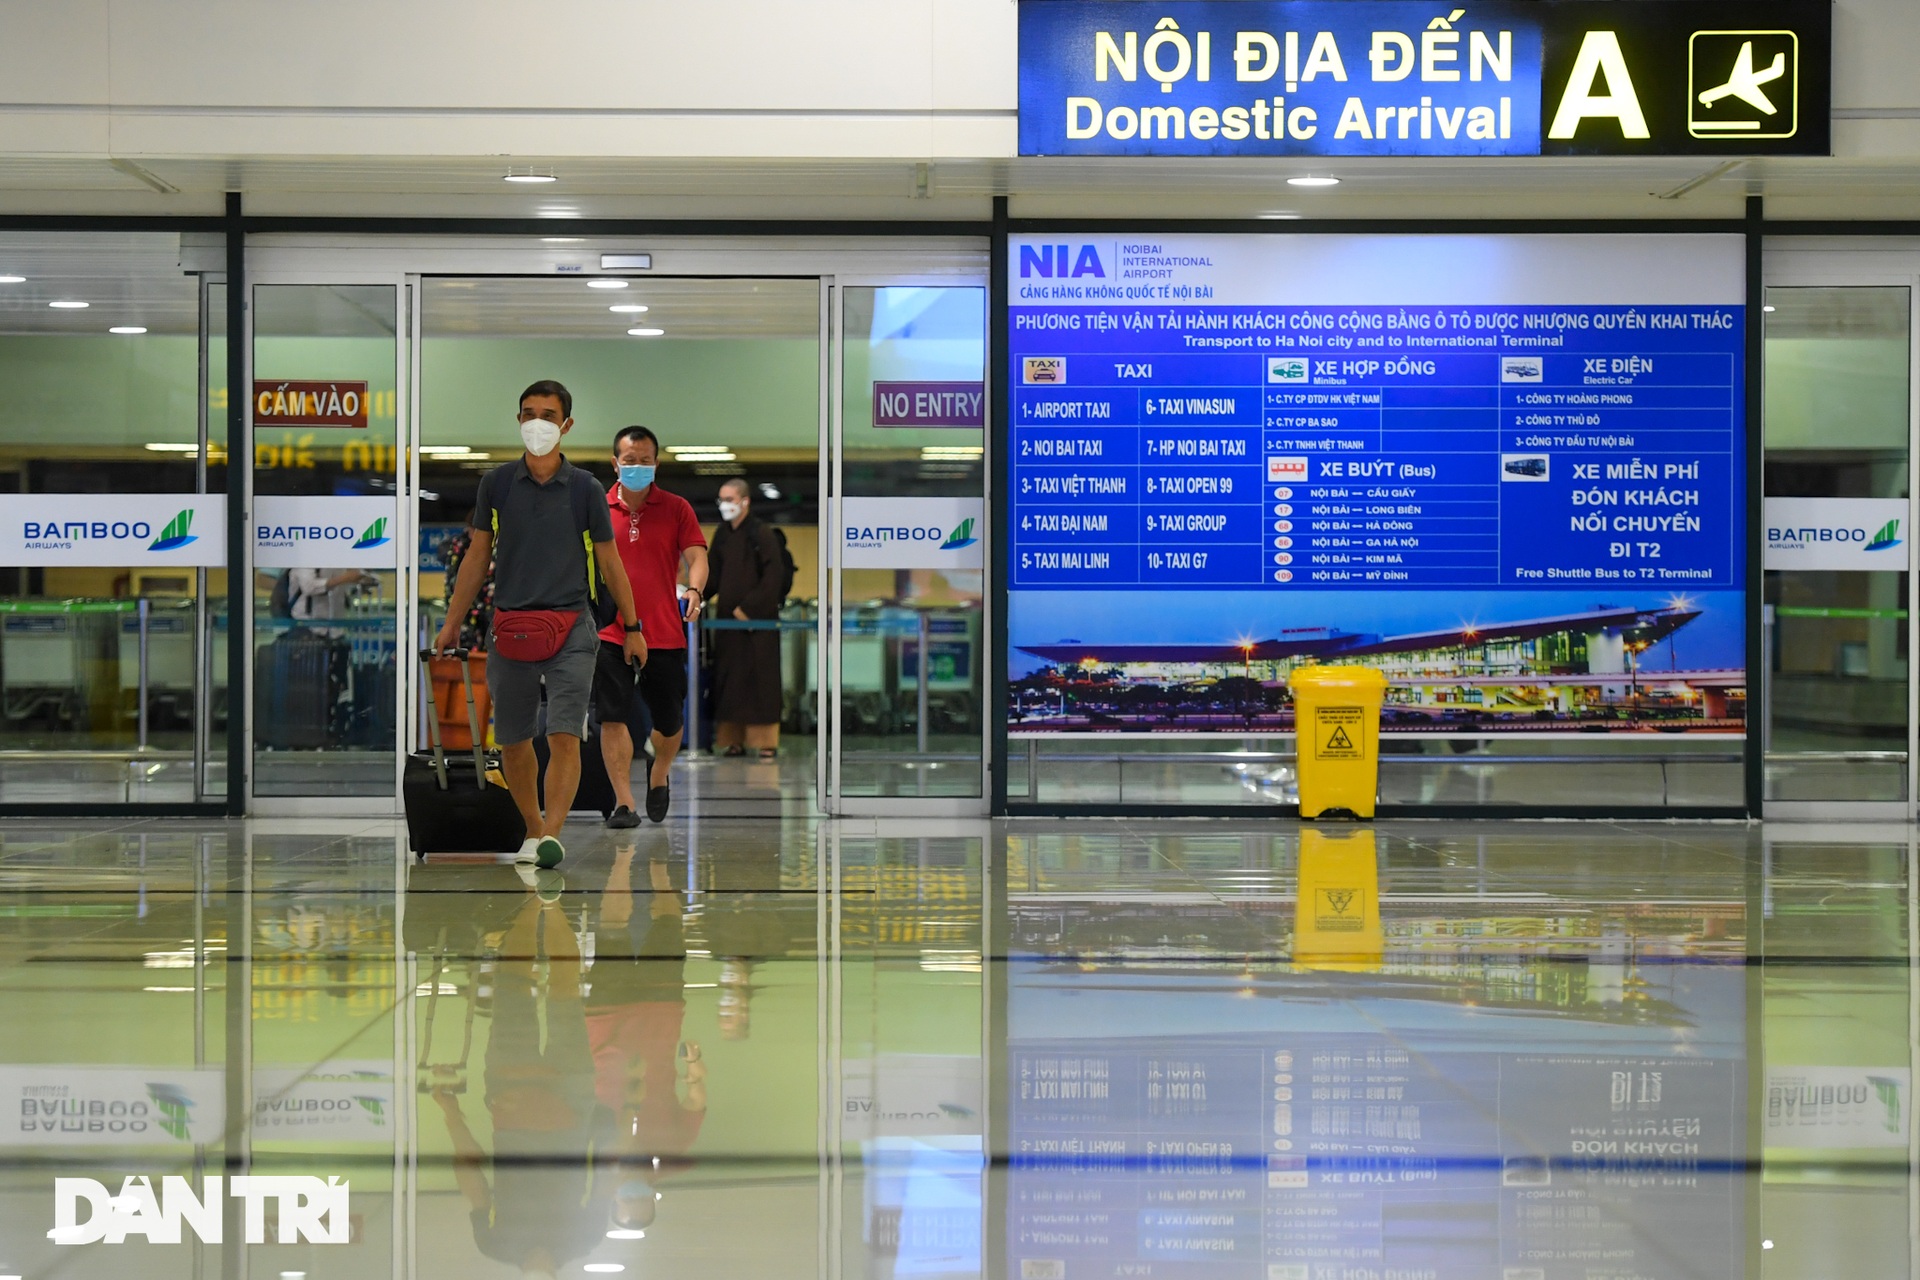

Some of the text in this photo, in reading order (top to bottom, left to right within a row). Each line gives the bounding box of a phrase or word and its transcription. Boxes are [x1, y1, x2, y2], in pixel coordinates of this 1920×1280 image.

[1090, 10, 1512, 93] NỘI ĐỊA ĐẾN
[1548, 31, 1650, 139] A
[1067, 96, 1511, 140] Domestic Arrival
[1123, 245, 1162, 254] NOIBAI
[1020, 245, 1105, 278] NIA
[1123, 257, 1212, 266] INTERNATIONAL
[1123, 269, 1173, 278] AIRPORT
[1020, 283, 1212, 301] CẢNG HÀNG KHÔNG QUỐC TẾ NỘI BÀI
[1016, 308, 1732, 333] PHƯƠNG TIỆN VẬN TẢI HÀNH KHÁCH CÔNG CỘNG BẰNG Ô TÔ ĐƯỢC NHƯỢNG QUYỀN KHAI THÁC
[1183, 335, 1563, 349] Transport to Ha Noi city and to International Terminal
[1029, 361, 1060, 369] TAXI
[1114, 364, 1152, 378] TAXI
[1314, 355, 1435, 378] XE HỢP ĐỒNG
[1584, 356, 1652, 378] XE ĐIỆN
[1313, 377, 1347, 385] Minibus
[1583, 376, 1633, 384] Electric Car
[258, 383, 305, 416] CẤM
[313, 384, 359, 417] VÀO
[880, 392, 982, 418] NO ENTRY
[1158, 399, 1184, 414] TAXI
[1186, 398, 1235, 414] VINASUN
[1554, 395, 1565, 403] TY
[1601, 395, 1633, 404] PHONG
[1034, 402, 1083, 418] AIRPORT
[1085, 402, 1110, 418] TAXI
[1295, 418, 1306, 427] CP
[1308, 418, 1320, 427] BA
[1321, 418, 1338, 427] SAO
[1554, 416, 1565, 425] TY
[1034, 440, 1053, 456] NOI
[1056, 440, 1075, 456] BAI
[1077, 440, 1102, 456] TAXI
[1160, 440, 1175, 455] HP
[1178, 440, 1196, 456] NOI
[1200, 440, 1218, 456] BAI
[1220, 440, 1245, 456] TAXI
[1553, 437, 1565, 446] TY
[1601, 435, 1617, 448] NỘI
[1320, 459, 1436, 479] XE BUÝT (Bus)
[1573, 458, 1699, 479] XE MIỄN PHÍ
[1034, 477, 1059, 493] TAXI
[1061, 474, 1086, 497] VIỆT
[1088, 477, 1126, 493] THANH
[1159, 477, 1184, 493] TAXI
[1187, 477, 1217, 493] OPEN
[1220, 477, 1232, 493] 99
[1571, 486, 1698, 505] ĐÓN KHÁCH
[1279, 506, 1289, 514] 17
[1366, 506, 1395, 514] LONG
[1034, 515, 1059, 531] TAXI
[1061, 515, 1080, 535] ĐẠI
[1083, 515, 1107, 531] NAM
[1159, 515, 1184, 531] TAXI
[1187, 515, 1226, 531] GROUP
[1571, 510, 1700, 531] NỐI CHUYẾN
[24, 522, 150, 540] BAMBOO
[258, 526, 354, 540] BAMBOO
[846, 527, 942, 541] BAMBOO
[1768, 528, 1866, 542] BAMBOO
[1610, 542, 1660, 557] ĐI T2
[1034, 553, 1059, 568] TAXI
[1062, 553, 1081, 568] MAI
[1084, 553, 1109, 568] LINH
[1165, 553, 1190, 568] TAXI
[1193, 552, 1208, 569] G7
[1516, 568, 1712, 578] Free Shuttle Bus to T2 Terminal
